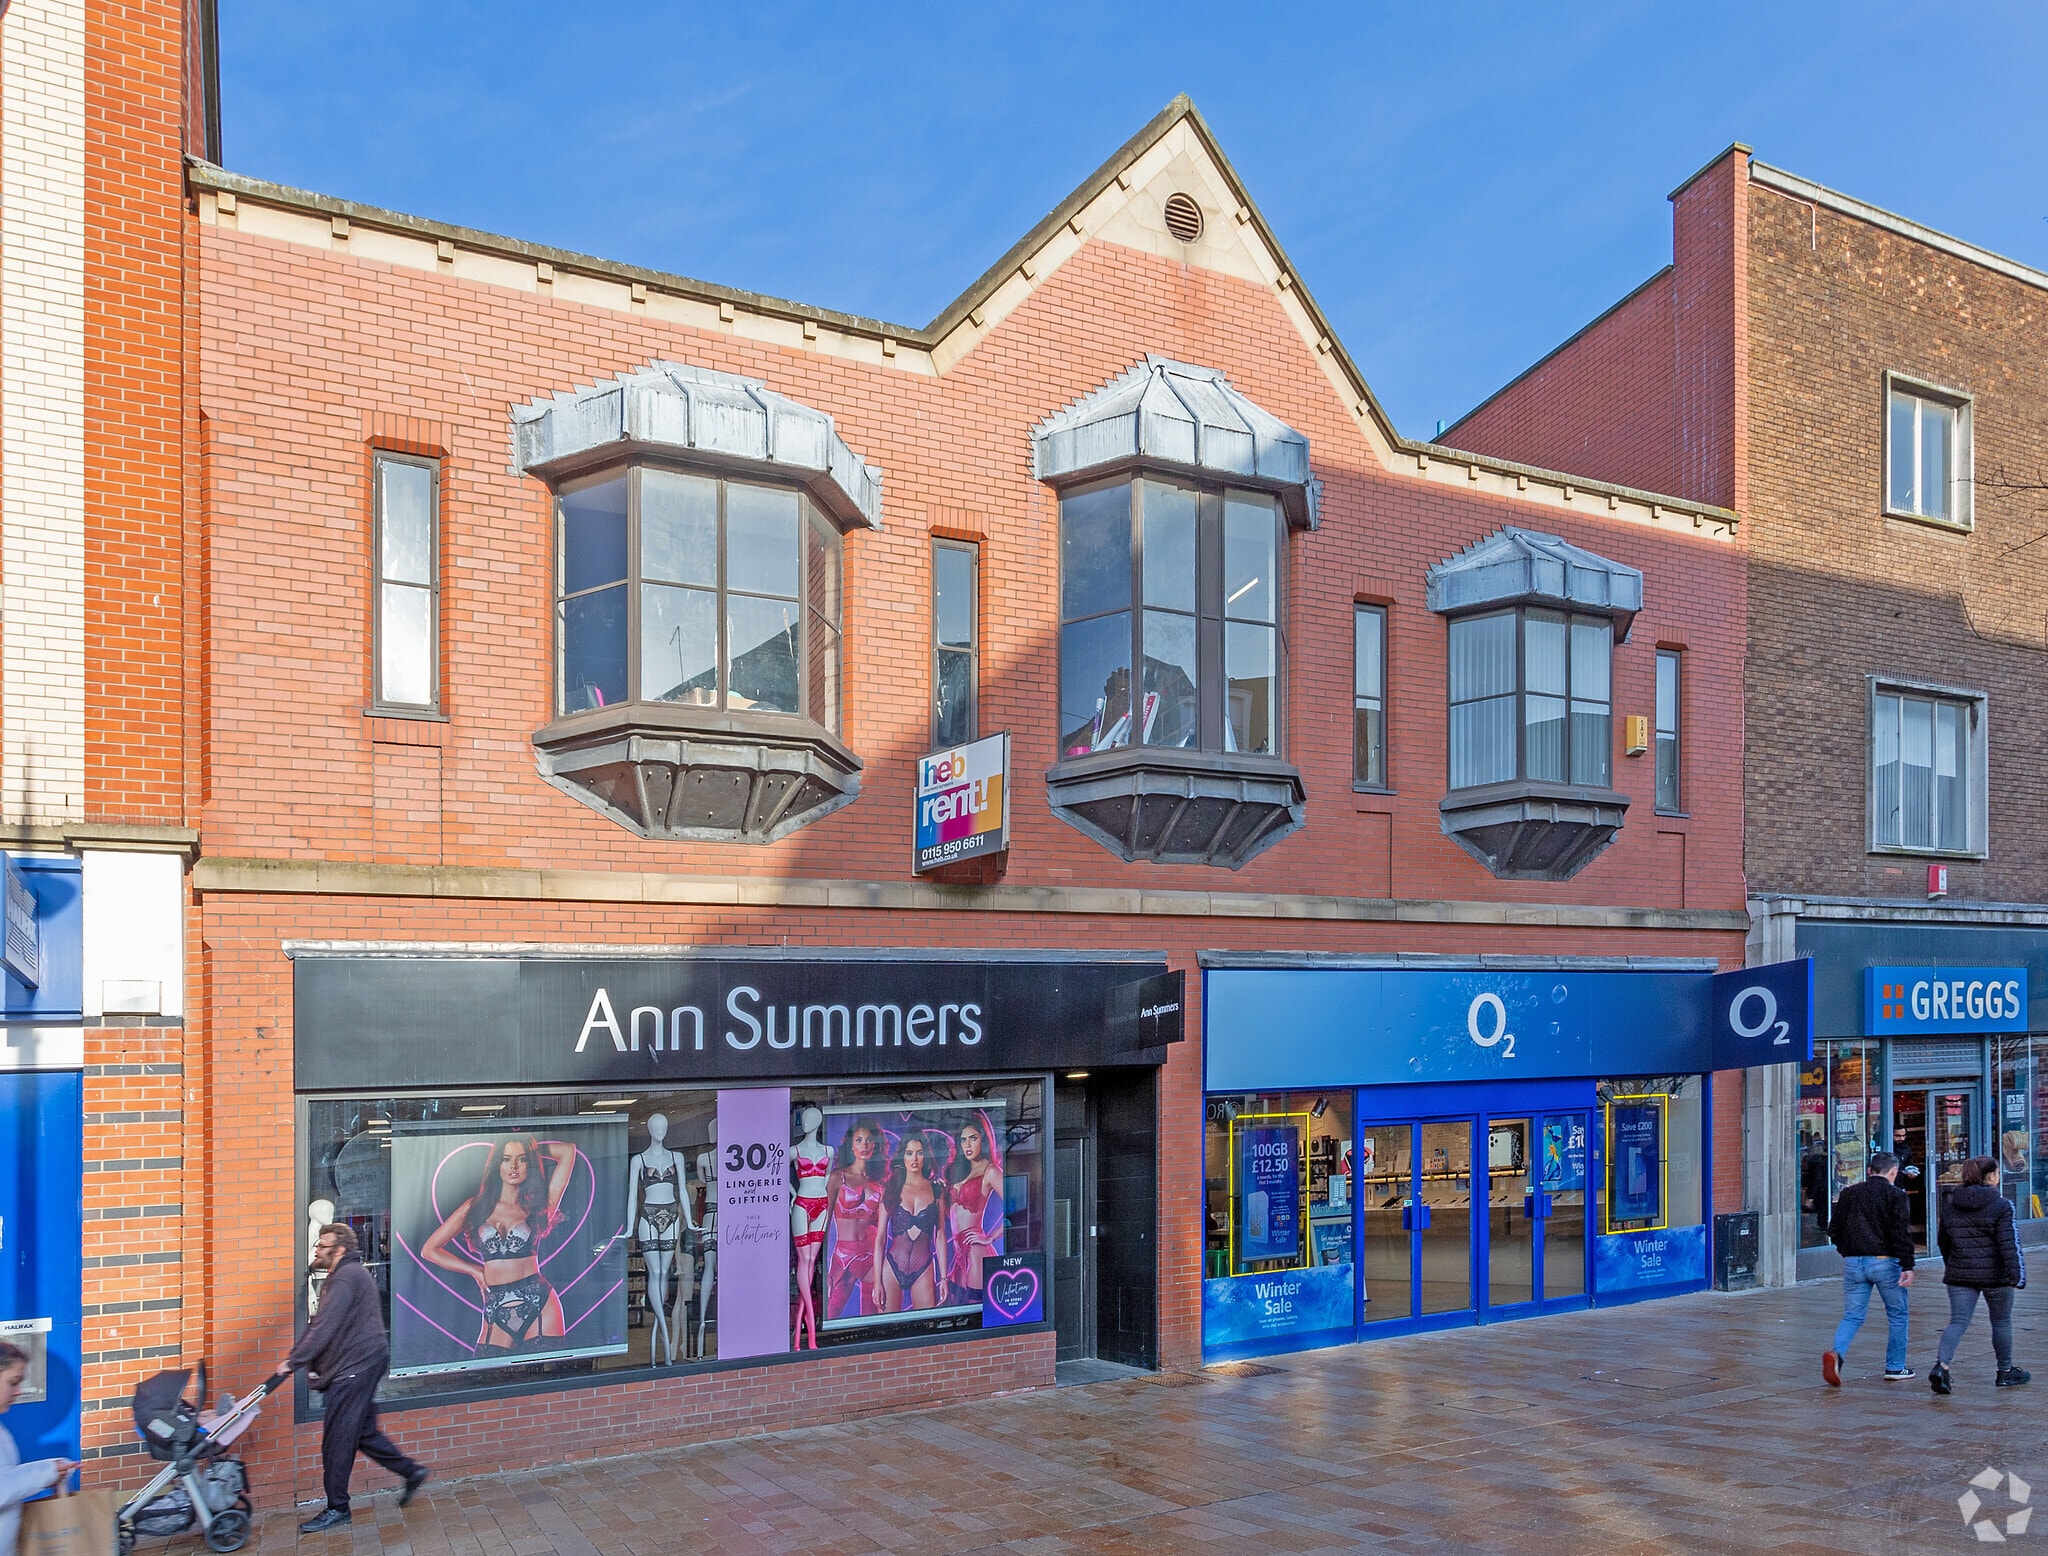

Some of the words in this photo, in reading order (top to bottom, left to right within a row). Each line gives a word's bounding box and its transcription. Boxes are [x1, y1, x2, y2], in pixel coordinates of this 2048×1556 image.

[924, 752, 965, 787] heb
[922, 776, 989, 827] rent!
[922, 846, 942, 860] 0115
[944, 841, 961, 856] 950
[963, 835, 984, 850] 6611
[922, 853, 958, 867] www.heb.co.uk
[1911, 980, 2020, 1020] GREGGS
[1140, 1008, 1152, 1018] Ann
[1152, 1003, 1179, 1015] Summers
[574, 988, 703, 1052] Ann
[725, 986, 982, 1050] Summers
[2006, 1094, 2016, 1104] IT'S
[2015, 1094, 2025, 1103] THE
[1836, 1111, 1858, 1121] HUNGER
[1621, 1123, 1636, 1132] Save
[1637, 1121, 1653, 1131] £200
[1836, 1119, 1857, 1133] AWAY
[725, 1143, 784, 1172] 30%
[1252, 1142, 1288, 1158] 100GB
[726, 1178, 782, 1188] LINGERIE
[728, 1195, 780, 1205] GIFTING
[1271, 1229, 1290, 1238] Winter
[1633, 1239, 1668, 1254] Winter
[1003, 1257, 1022, 1266] NEW
[1641, 1253, 1662, 1268] Sale
[1255, 1282, 1302, 1299] Winter
[1265, 1297, 1292, 1316] Sale
[4, 1322, 34, 1331] HALIFAX
